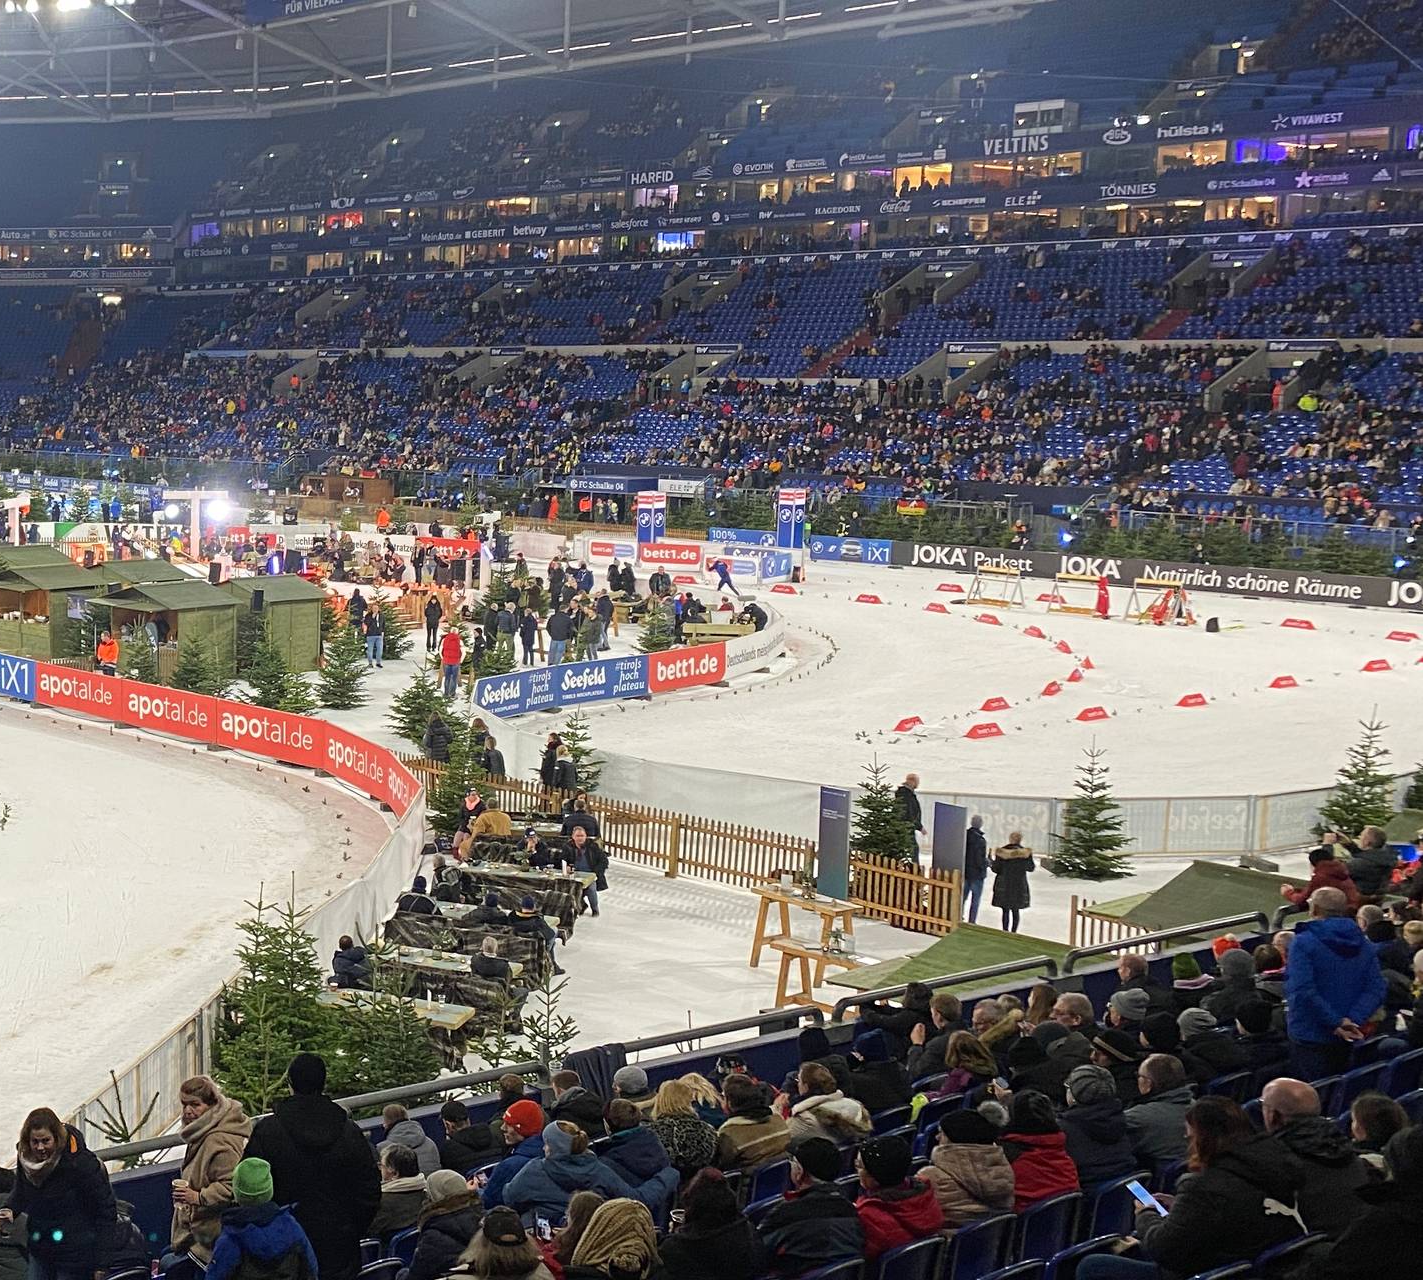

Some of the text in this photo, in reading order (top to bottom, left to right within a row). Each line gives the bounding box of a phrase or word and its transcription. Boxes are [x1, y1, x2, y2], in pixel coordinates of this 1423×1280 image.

[285, 1, 303, 14] FÜR
[1291, 112, 1344, 126] VIVAWEST
[1157, 124, 1210, 139] hülsta
[983, 135, 1049, 156] VELTINS
[631, 171, 674, 185] HARFID
[1100, 182, 1156, 196] TÖNNIES
[1005, 195, 1026, 207] ELE
[815, 205, 861, 215] HAGEDORN
[513, 225, 548, 237] betway
[611, 219, 649, 230] salesforce
[472, 228, 506, 238] GEBERIT
[69, 270, 89, 279] AOK
[588, 481, 614, 490] Schalke
[615, 482, 624, 491] 04
[712, 530, 737, 539] 100%
[643, 547, 698, 560] bett1.de
[868, 547, 890, 562] iX1
[912, 545, 1033, 572] JOKA Parkett
[1227, 574, 1289, 594] schöne
[1294, 576, 1362, 600] Räume
[657, 653, 718, 682] bett1.de
[1, 658, 28, 695] iX1
[561, 666, 606, 691] Seefeld
[40, 671, 113, 705] apotal.de
[482, 680, 520, 707] Seefeld
[613, 680, 645, 695] plateau
[526, 693, 554, 711] plateau
[128, 691, 208, 729] apotal.de
[221, 712, 314, 751] apotal.de
[328, 737, 384, 784] apotal.de
